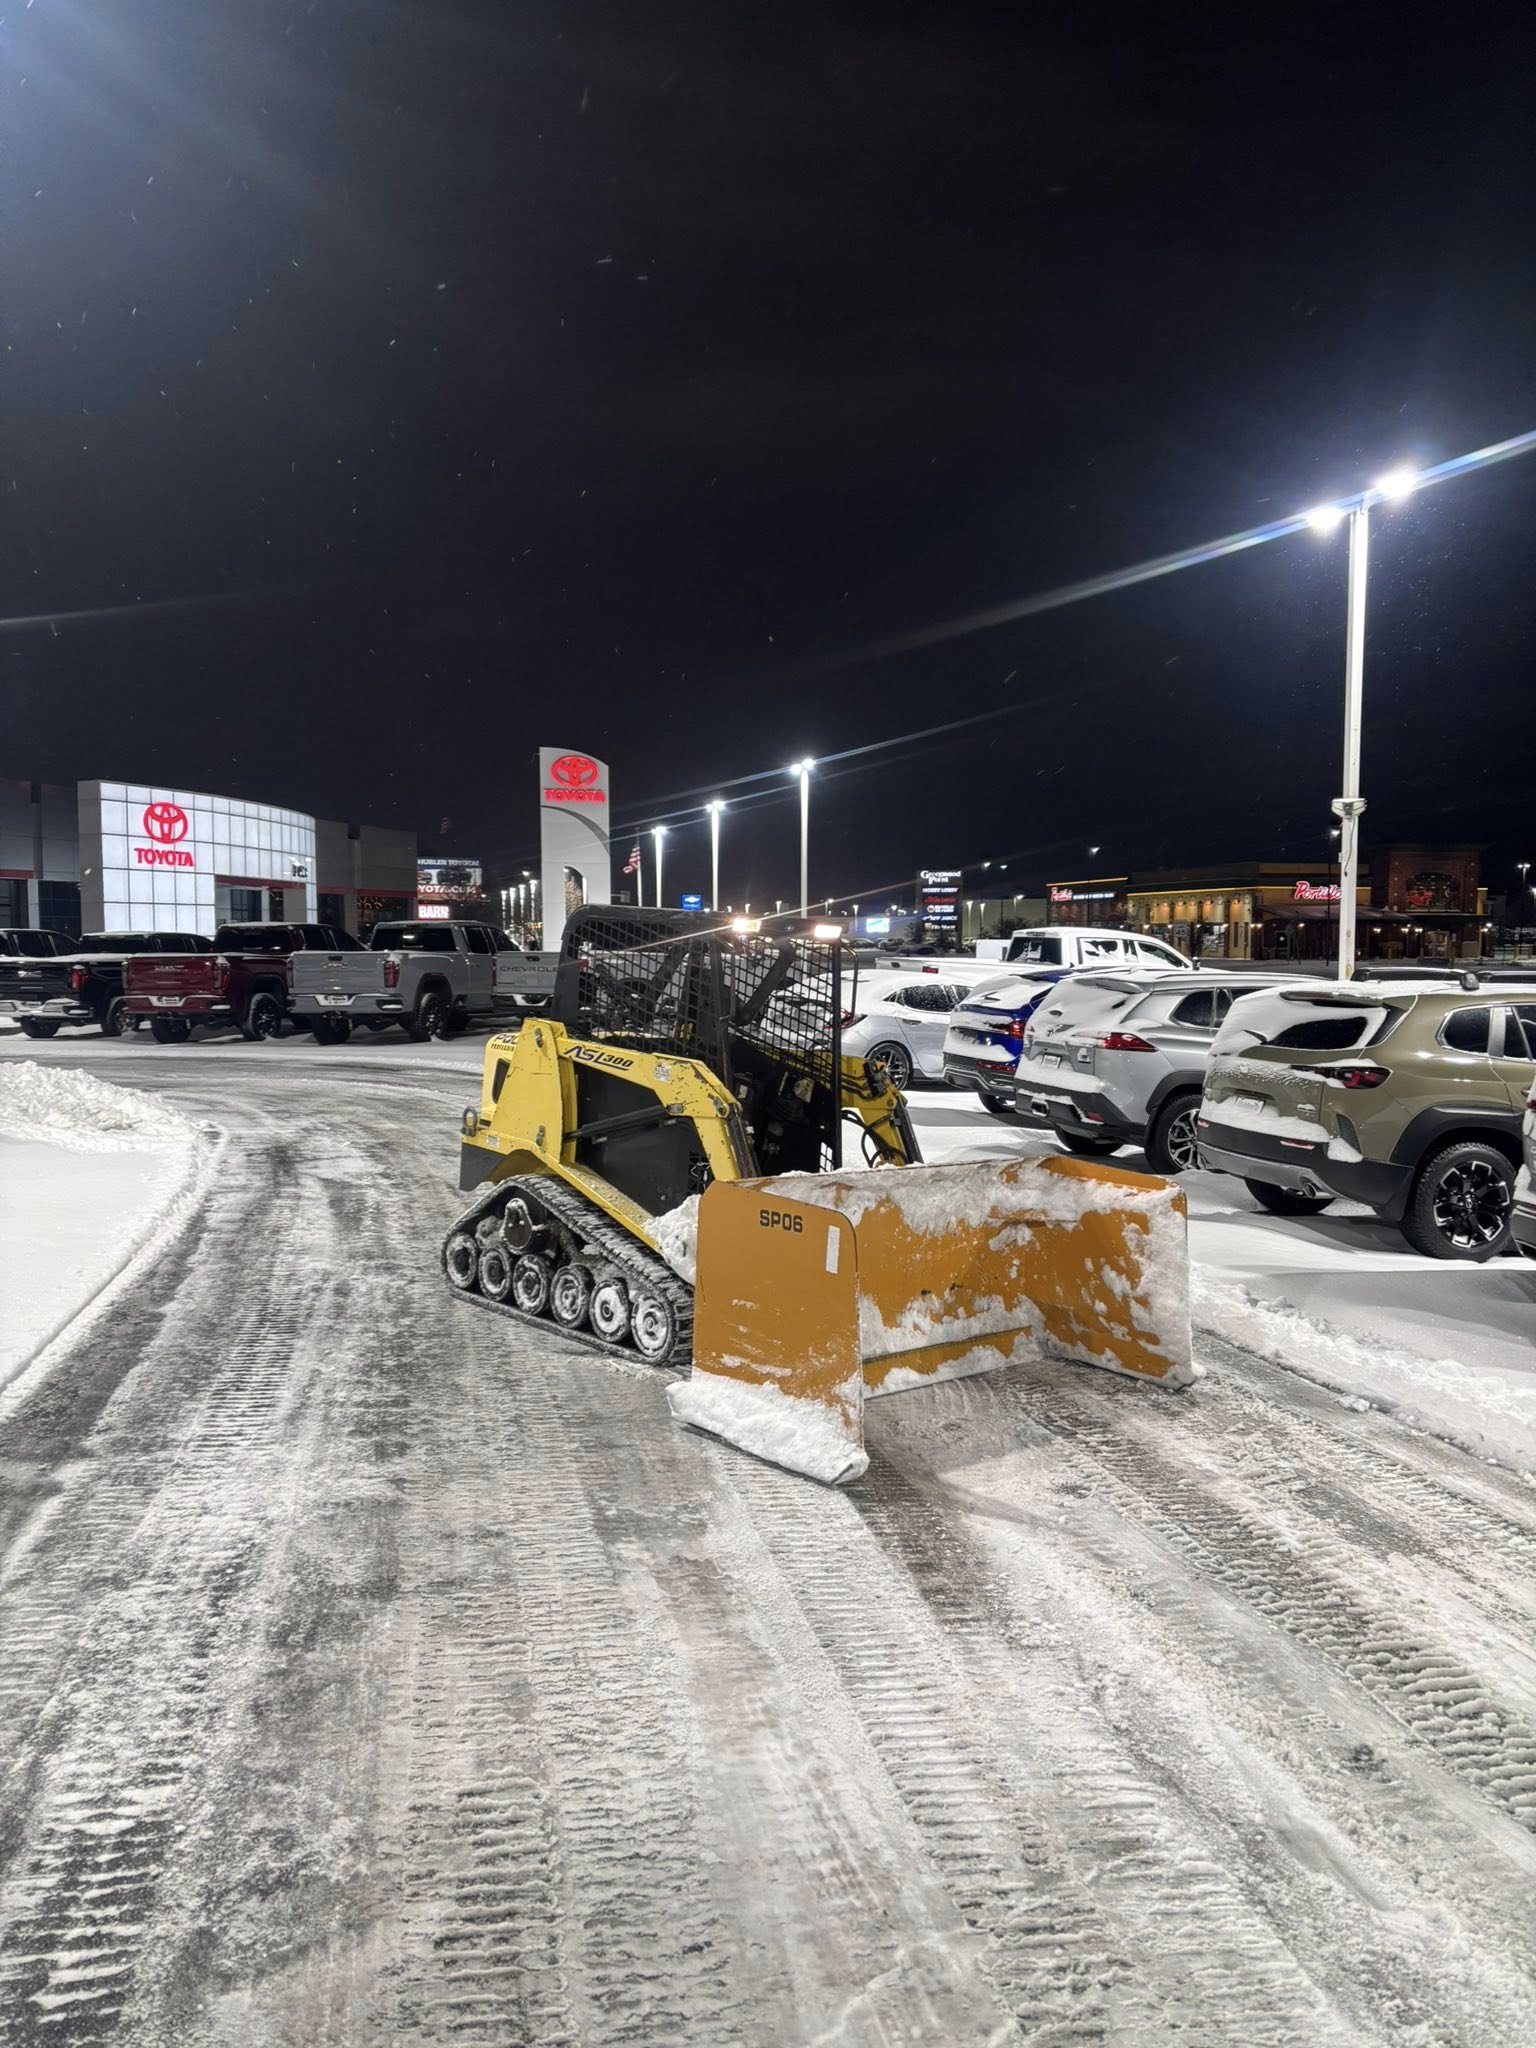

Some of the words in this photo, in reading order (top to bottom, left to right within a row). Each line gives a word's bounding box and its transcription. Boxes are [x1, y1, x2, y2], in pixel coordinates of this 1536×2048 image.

[544, 788, 606, 802] TOYOTA
[134, 847, 195, 867] TOYOTA
[1294, 880, 1343, 900] Portillo
[759, 1209, 803, 1233] SP06
